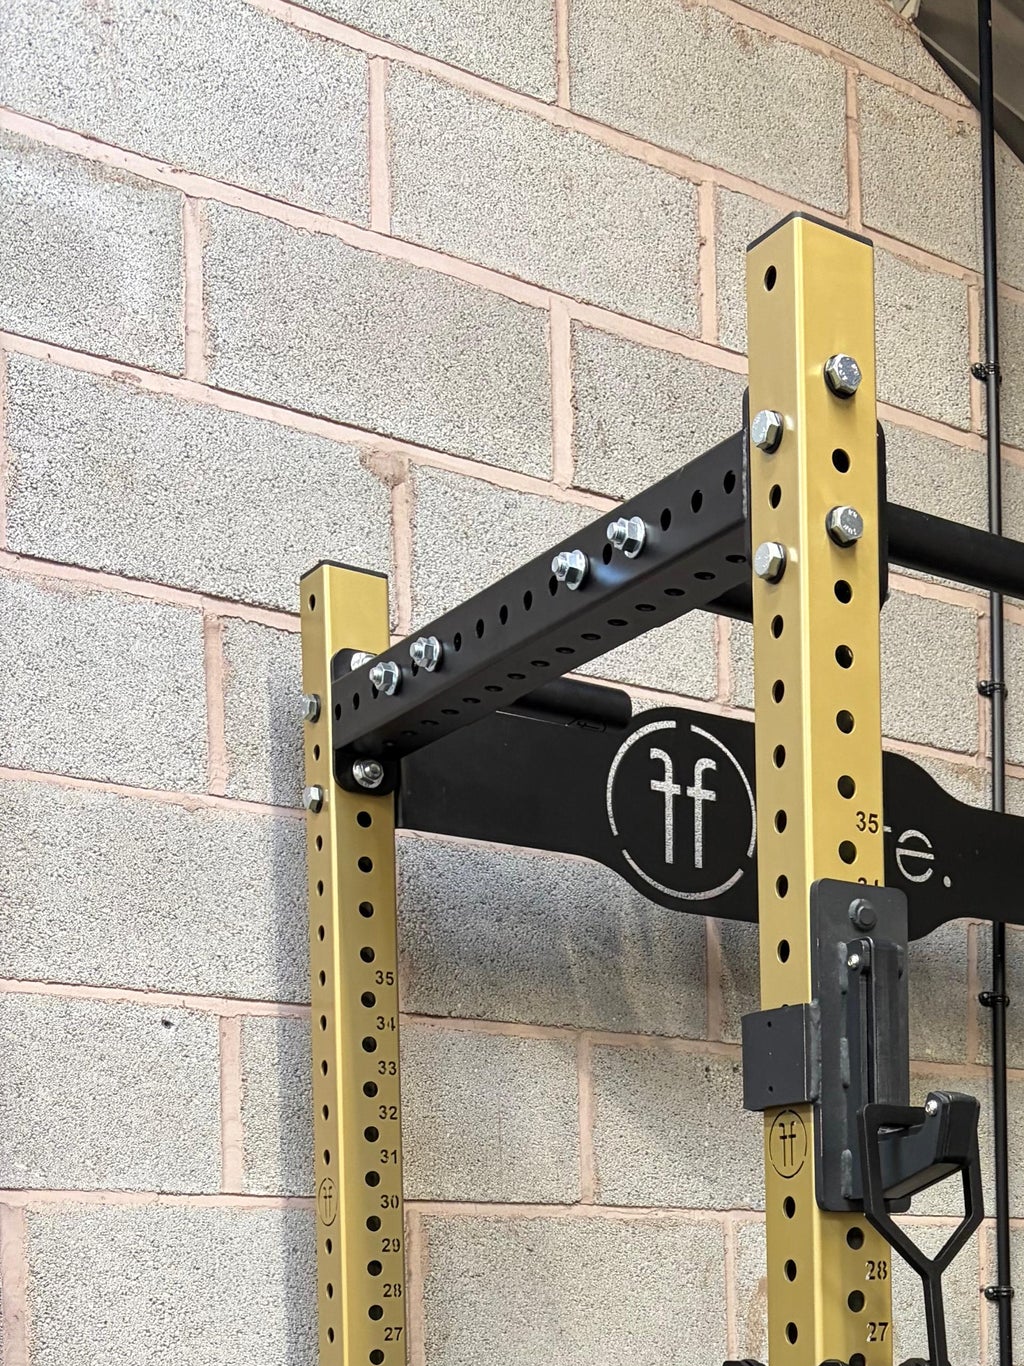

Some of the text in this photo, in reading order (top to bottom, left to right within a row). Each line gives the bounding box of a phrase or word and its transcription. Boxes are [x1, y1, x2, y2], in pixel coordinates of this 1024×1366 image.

[856, 810, 879, 834] 35
[376, 970, 394, 986] 35
[376, 1016, 396, 1032] 34
[378, 1060, 397, 1075] 33
[378, 1106, 398, 1120] 32
[380, 1150, 397, 1164] 31
[380, 1195, 399, 1208] 30
[382, 1238, 400, 1252] 29
[865, 1260, 887, 1280] 28
[383, 1284, 402, 1298] 28
[384, 1327, 403, 1341] 27
[866, 1322, 889, 1342] 27
